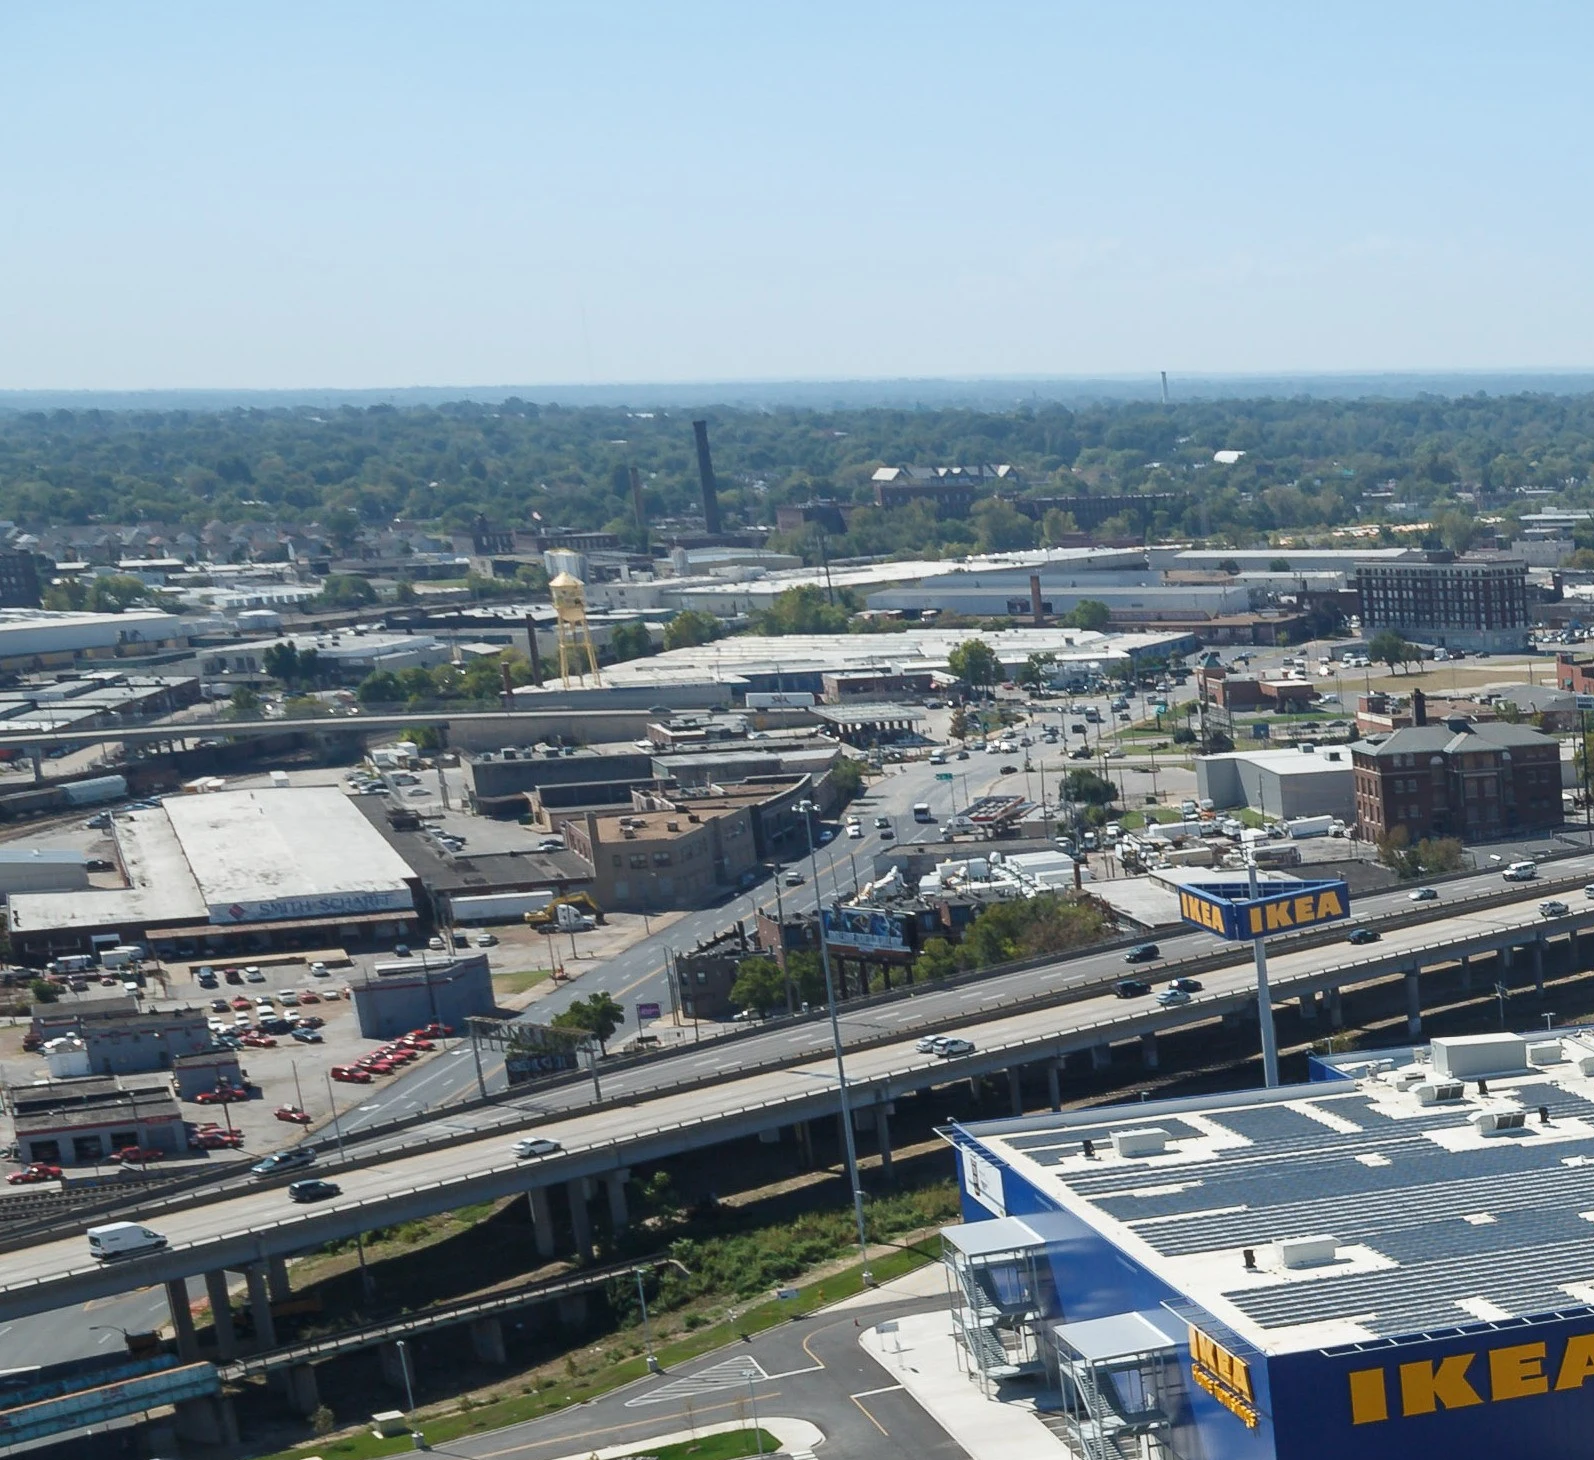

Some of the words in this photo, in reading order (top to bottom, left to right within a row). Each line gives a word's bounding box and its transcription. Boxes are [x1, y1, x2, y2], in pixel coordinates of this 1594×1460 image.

[259, 899, 314, 916] SMITH
[1181, 891, 1226, 934] IKEA
[1249, 891, 1343, 934] IKEA
[1188, 1322, 1254, 1404] IKEA
